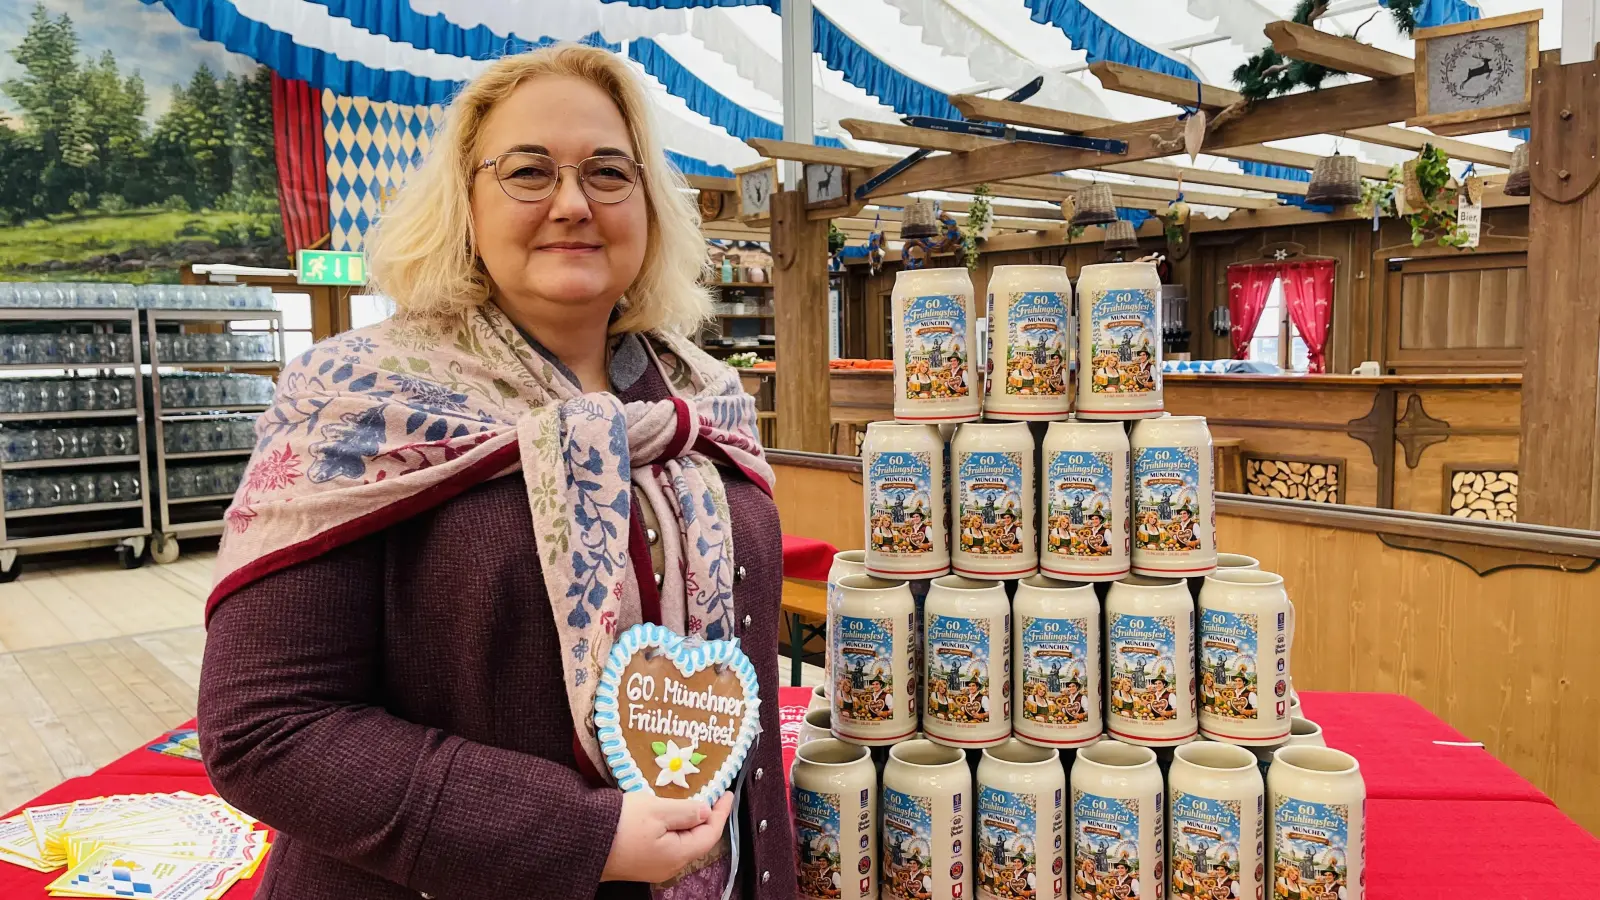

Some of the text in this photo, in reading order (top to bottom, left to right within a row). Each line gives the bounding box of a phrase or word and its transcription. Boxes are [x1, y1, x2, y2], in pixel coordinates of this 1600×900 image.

[925, 299, 942, 309] 60.
[1033, 295, 1050, 305] 60.
[1116, 292, 1133, 303] 60.
[910, 306, 960, 322] Frühlingsfest
[1016, 303, 1064, 318] Frühlingsfest
[1099, 301, 1150, 316] Frühlingsfest
[888, 455, 905, 465] 60.
[979, 455, 997, 465] 60.
[1068, 454, 1086, 465] 60.
[1154, 450, 1172, 461] 60.
[874, 463, 923, 477] Frühlingsfest
[965, 463, 1014, 477] Frühlingsfest
[1053, 462, 1104, 477] Frühlingsfest
[1140, 459, 1190, 473] Frühlingsfest
[849, 620, 866, 631] 60.
[945, 620, 963, 631] 60.
[1129, 619, 1147, 630] 60.
[1212, 613, 1228, 625] 60.
[932, 626, 981, 642] Frühlingsfest
[1044, 622, 1062, 633] 60.
[1114, 625, 1166, 640] Frühlingsfest
[1028, 629, 1080, 643] Frühlingsfest
[627, 671, 747, 717] 60. Münchner
[628, 703, 737, 749] Frühlingsfest
[991, 792, 1008, 804] 60.
[980, 797, 1027, 816] Frühlingsfest
[1092, 800, 1109, 810] 60.
[1192, 799, 1210, 811] 60.
[1298, 804, 1317, 816] 60.
[1078, 804, 1130, 822] Frühlingsfest
[1177, 804, 1231, 823] Frühlingsfest
[1281, 809, 1339, 828] Frühlingsfest
